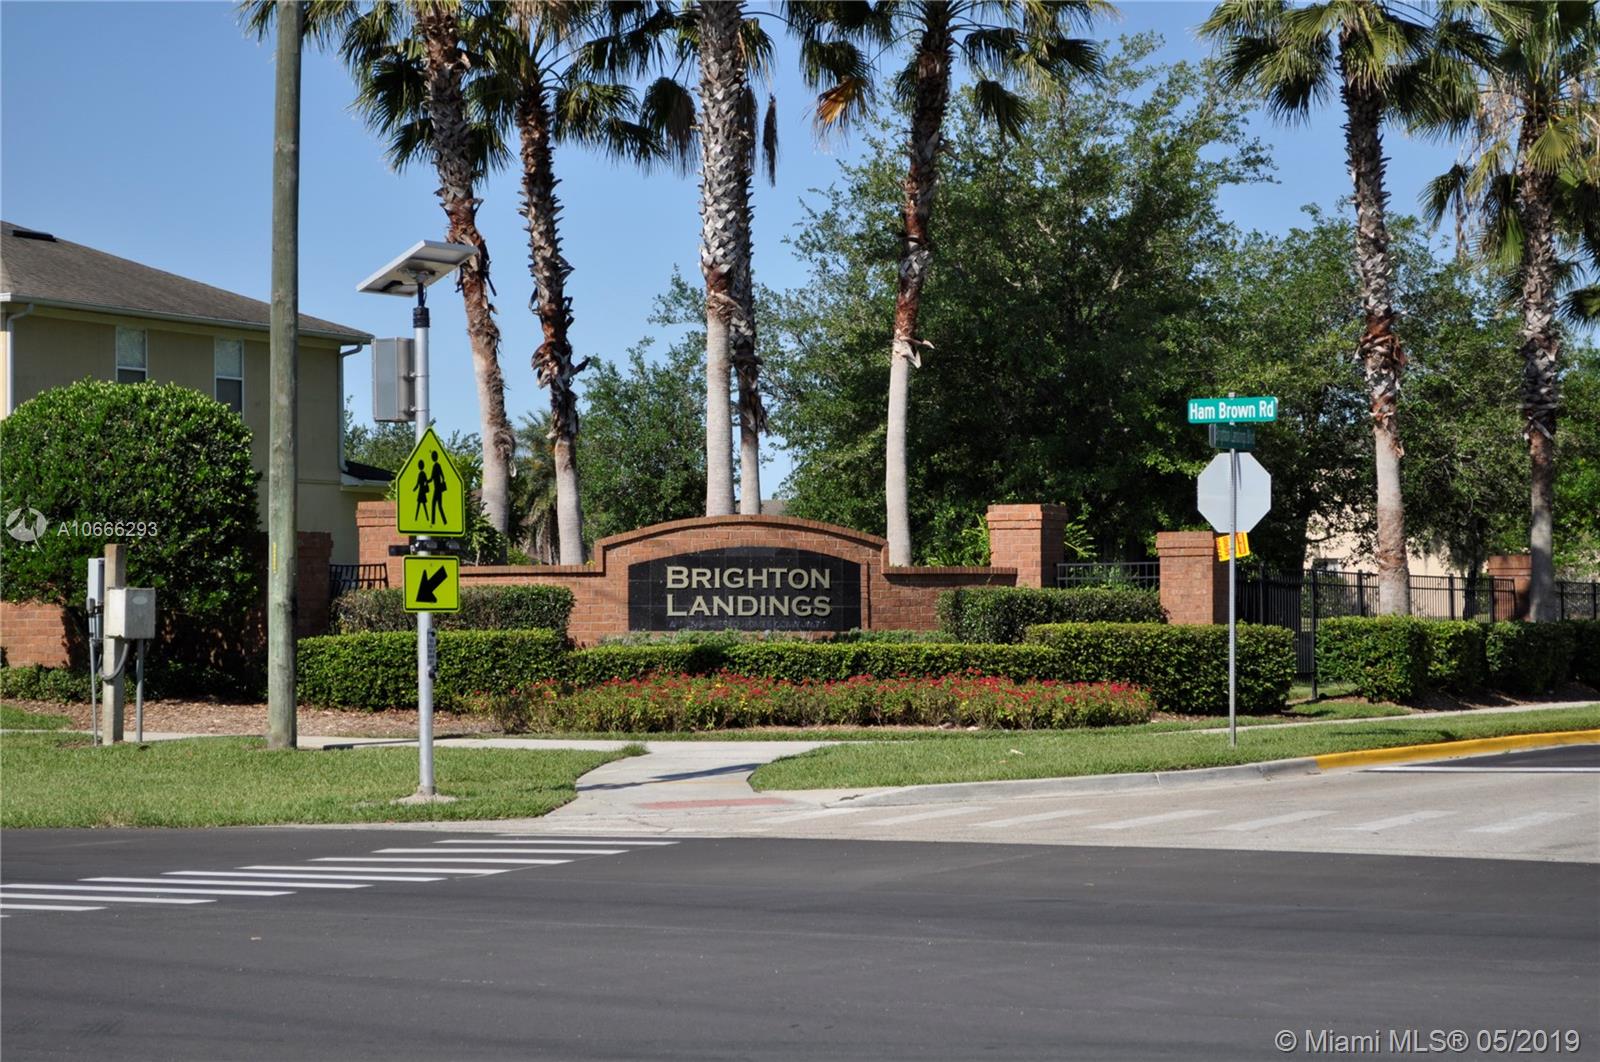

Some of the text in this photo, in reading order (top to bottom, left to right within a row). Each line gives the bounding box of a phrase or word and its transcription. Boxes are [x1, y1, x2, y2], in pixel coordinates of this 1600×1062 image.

[1189, 400, 1274, 420] Ham Brown Rd
[666, 566, 831, 589] BRIGHTON
[666, 594, 831, 617] LANDINGS
